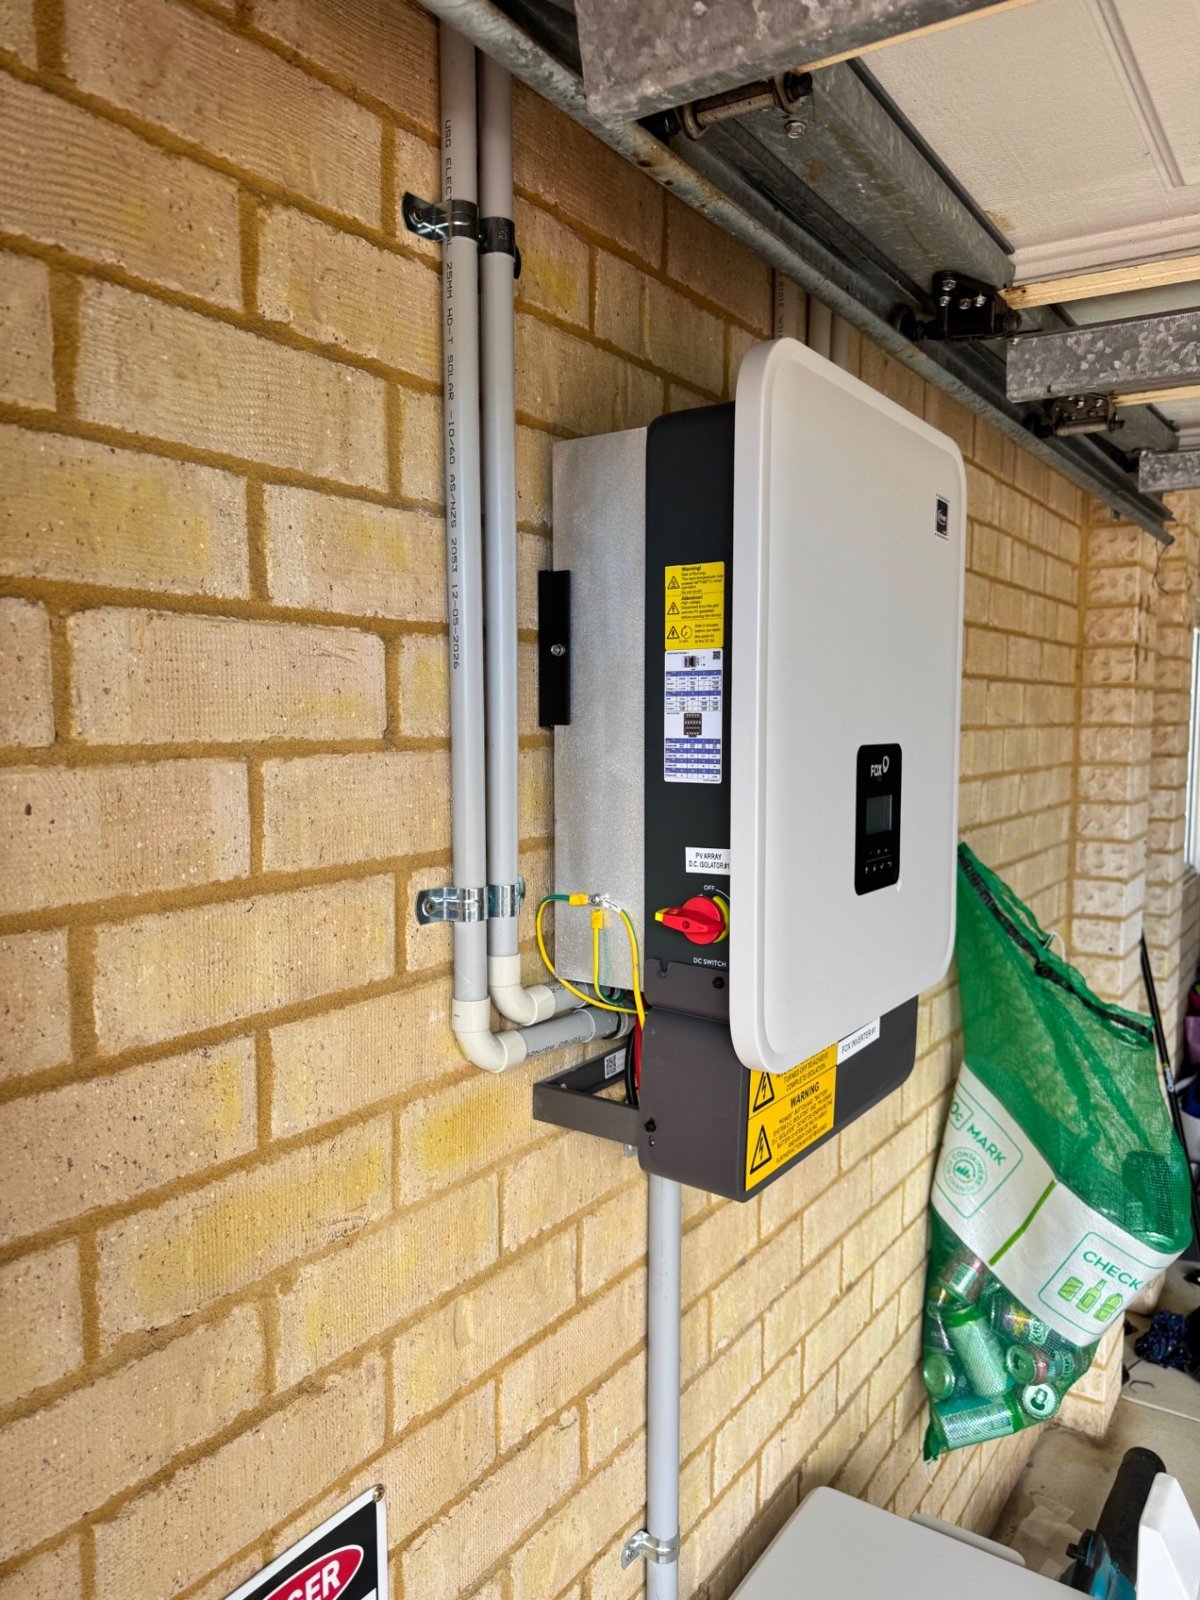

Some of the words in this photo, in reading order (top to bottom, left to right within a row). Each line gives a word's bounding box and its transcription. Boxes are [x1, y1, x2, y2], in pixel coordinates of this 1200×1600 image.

[444, 120, 452, 148] USG
[448, 410, 456, 465] -10/60
[449, 474, 457, 528] AS/NZS
[870, 764, 883, 777] FOX
[695, 852, 703, 860] PV
[703, 852, 722, 861] ARRAY
[700, 860, 723, 869] ISOLATOR
[692, 956, 703, 964] DC
[703, 958, 727, 968] SWITCH
[841, 1042, 851, 1055] FOX
[851, 1029, 872, 1048] INVERTER
[790, 1081, 820, 1109] WARNING
[967, 1123, 1007, 1166] MARK
[1083, 1250, 1144, 1291] CHECK
